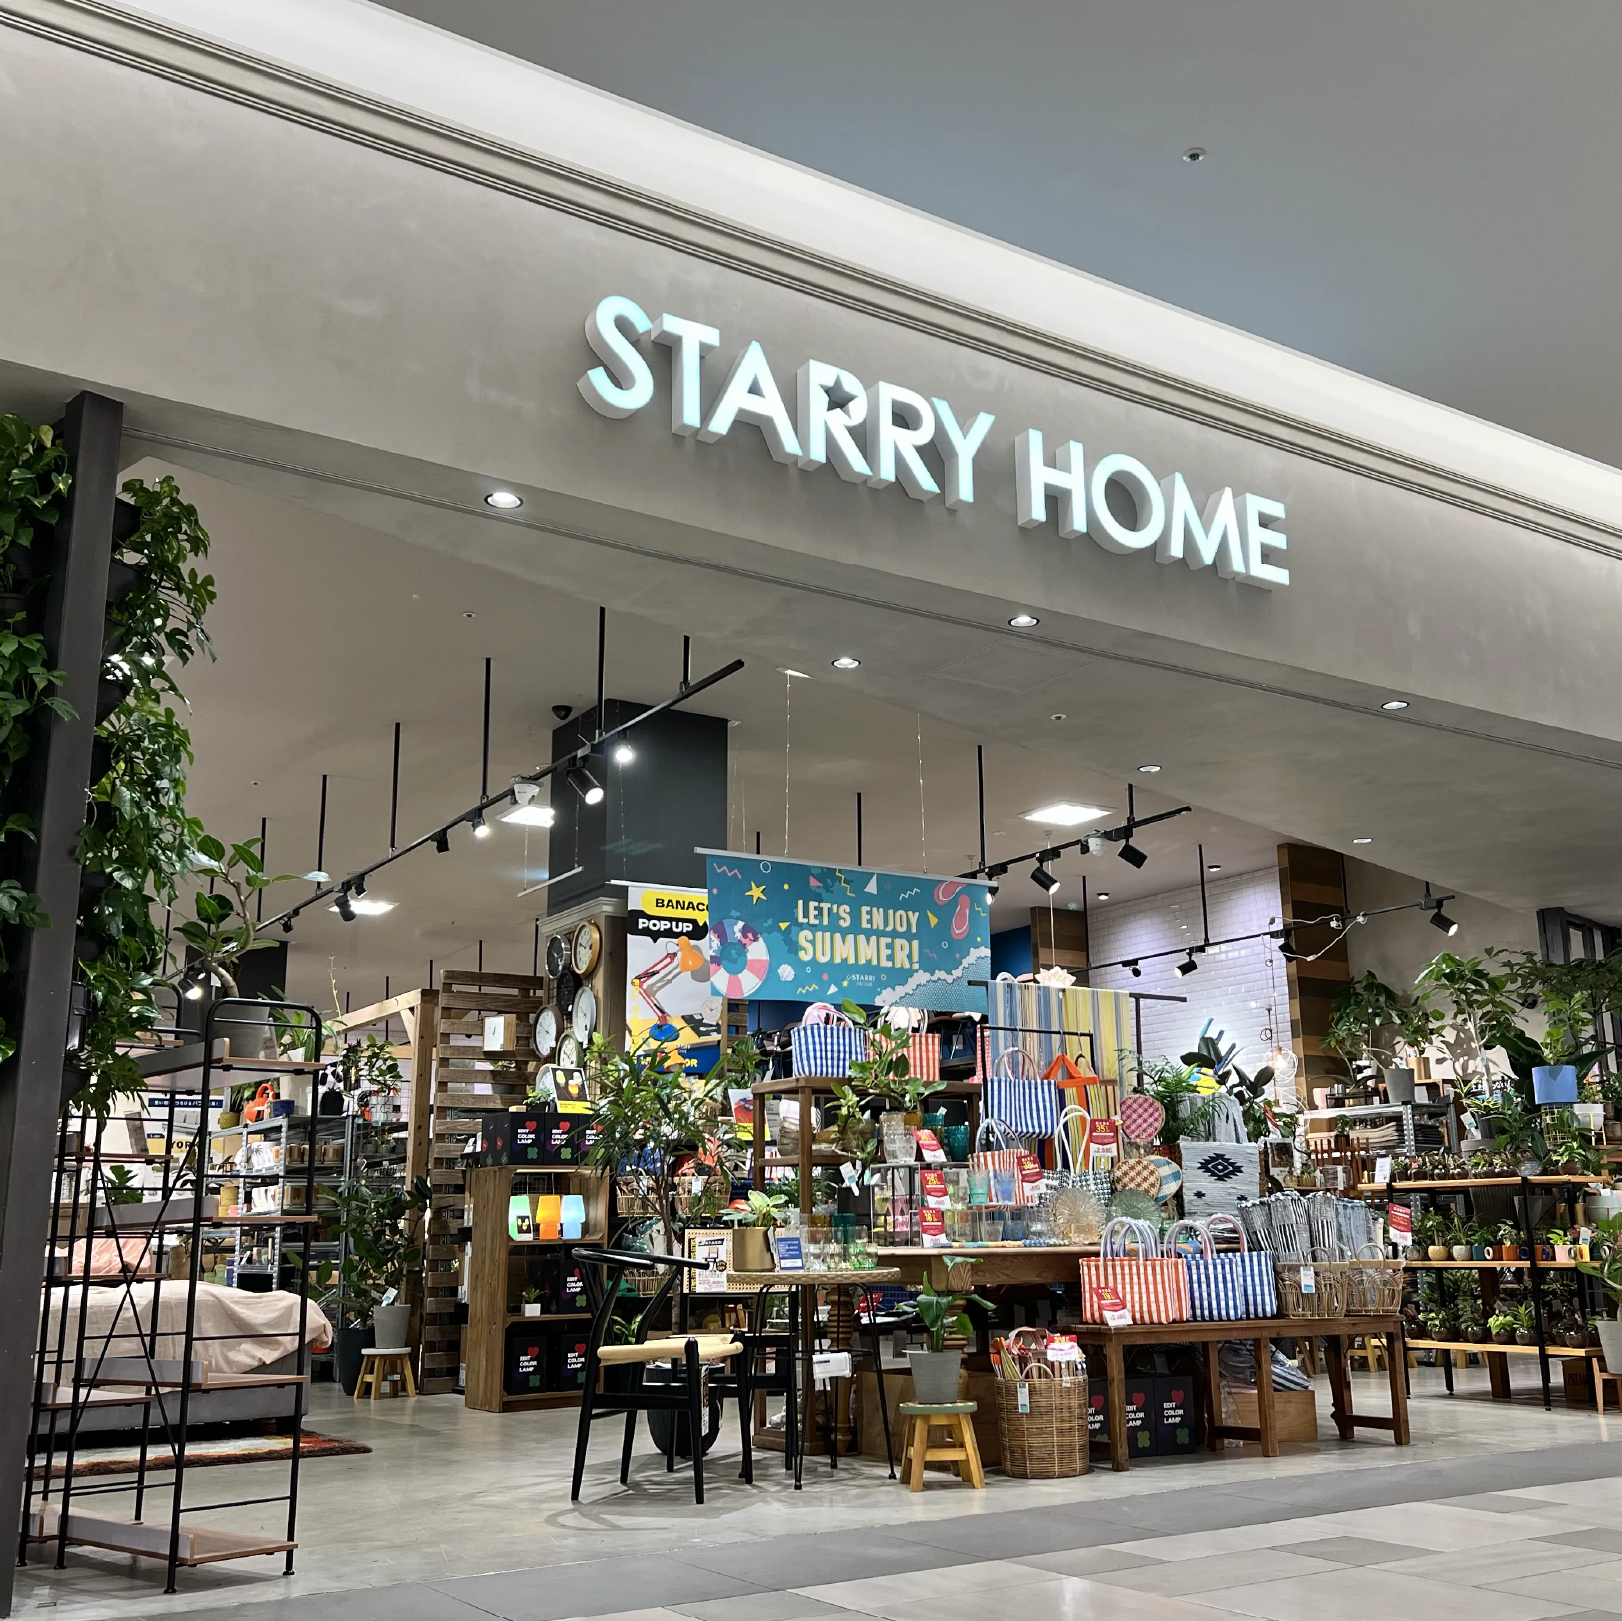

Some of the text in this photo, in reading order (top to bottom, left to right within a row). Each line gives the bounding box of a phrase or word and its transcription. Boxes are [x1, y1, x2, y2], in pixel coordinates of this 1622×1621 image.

[580, 295, 1291, 588] STARRY HOME
[655, 898, 709, 912] BANAC
[797, 900, 919, 934] LET'S ENJOY
[798, 930, 920, 970] SUMMER!
[1087, 1414, 1104, 1422] OLOR
[1163, 1416, 1182, 1424] LAMP
[1087, 1422, 1101, 1430] AMP
